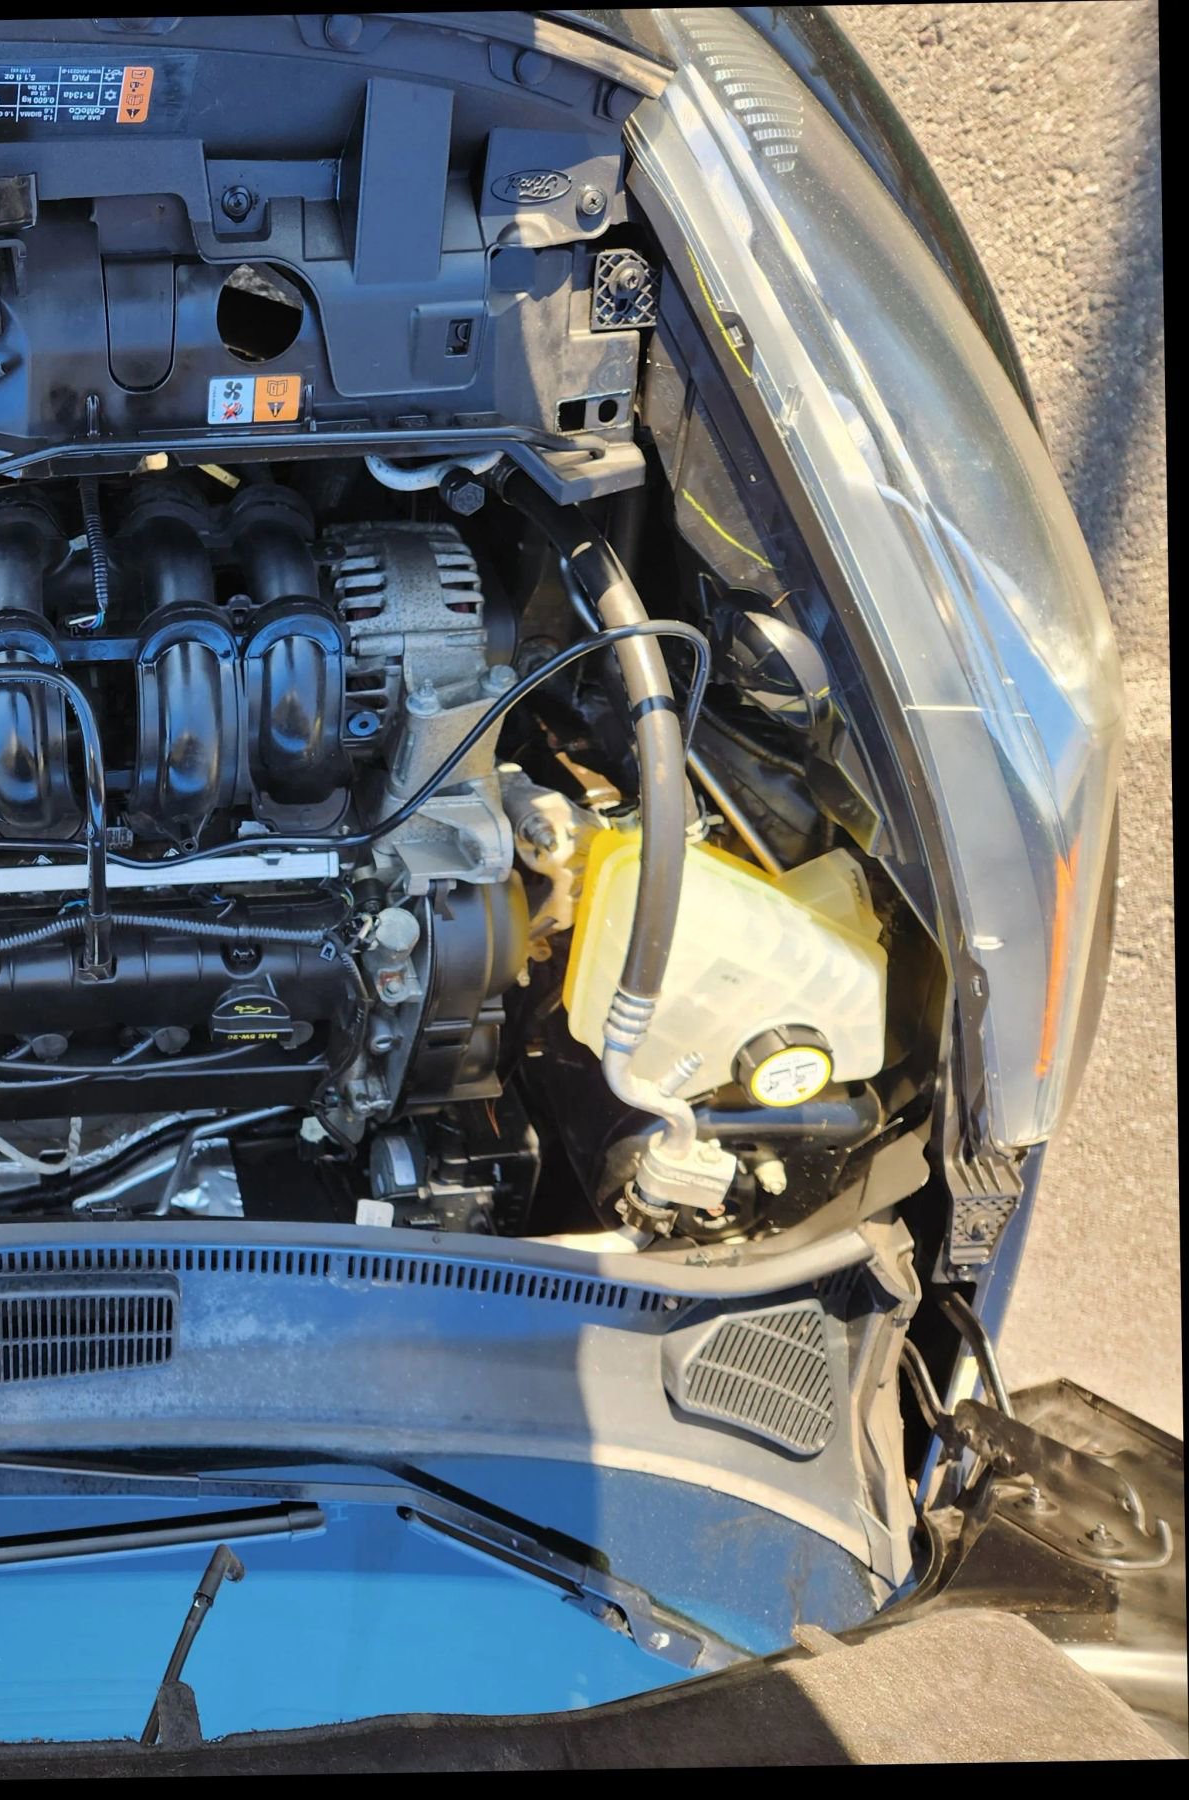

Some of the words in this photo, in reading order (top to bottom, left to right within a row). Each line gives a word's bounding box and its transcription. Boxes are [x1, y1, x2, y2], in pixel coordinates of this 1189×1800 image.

[72, 74, 90, 82] PAG
[64, 91, 94, 100] R-134a
[22, 96, 32, 104] kg
[34, 96, 55, 104] 0.600
[69, 108, 106, 116] FoMoCo
